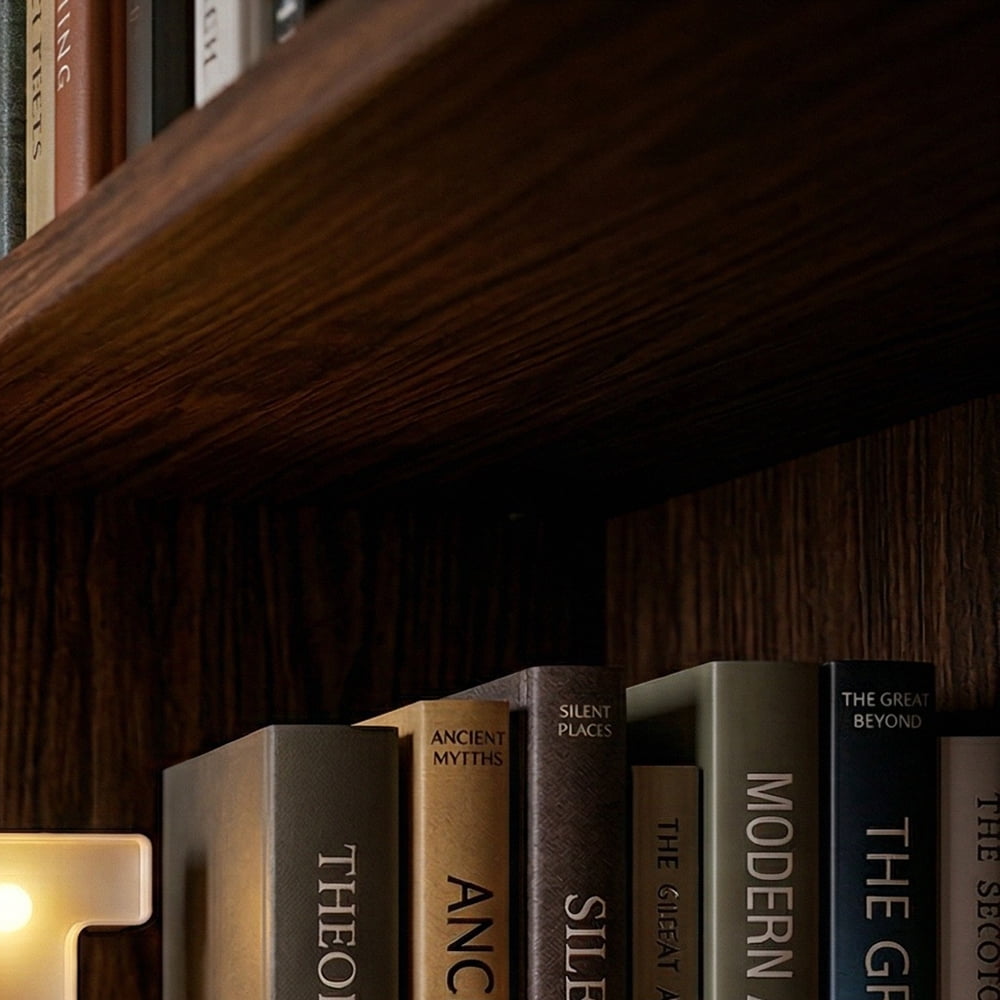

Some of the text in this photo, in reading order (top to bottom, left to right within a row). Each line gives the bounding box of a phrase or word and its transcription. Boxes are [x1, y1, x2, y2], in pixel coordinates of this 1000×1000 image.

[841, 691, 930, 707] THE GREAT
[559, 704, 612, 719] SILENT
[853, 713, 922, 729] BEYOND
[431, 729, 506, 746] ANCIENT
[558, 723, 612, 737] PLACES
[976, 792, 1000, 863] THE
[656, 818, 680, 870] THE
[745, 772, 794, 979] MODERN
[864, 817, 910, 920] THE
